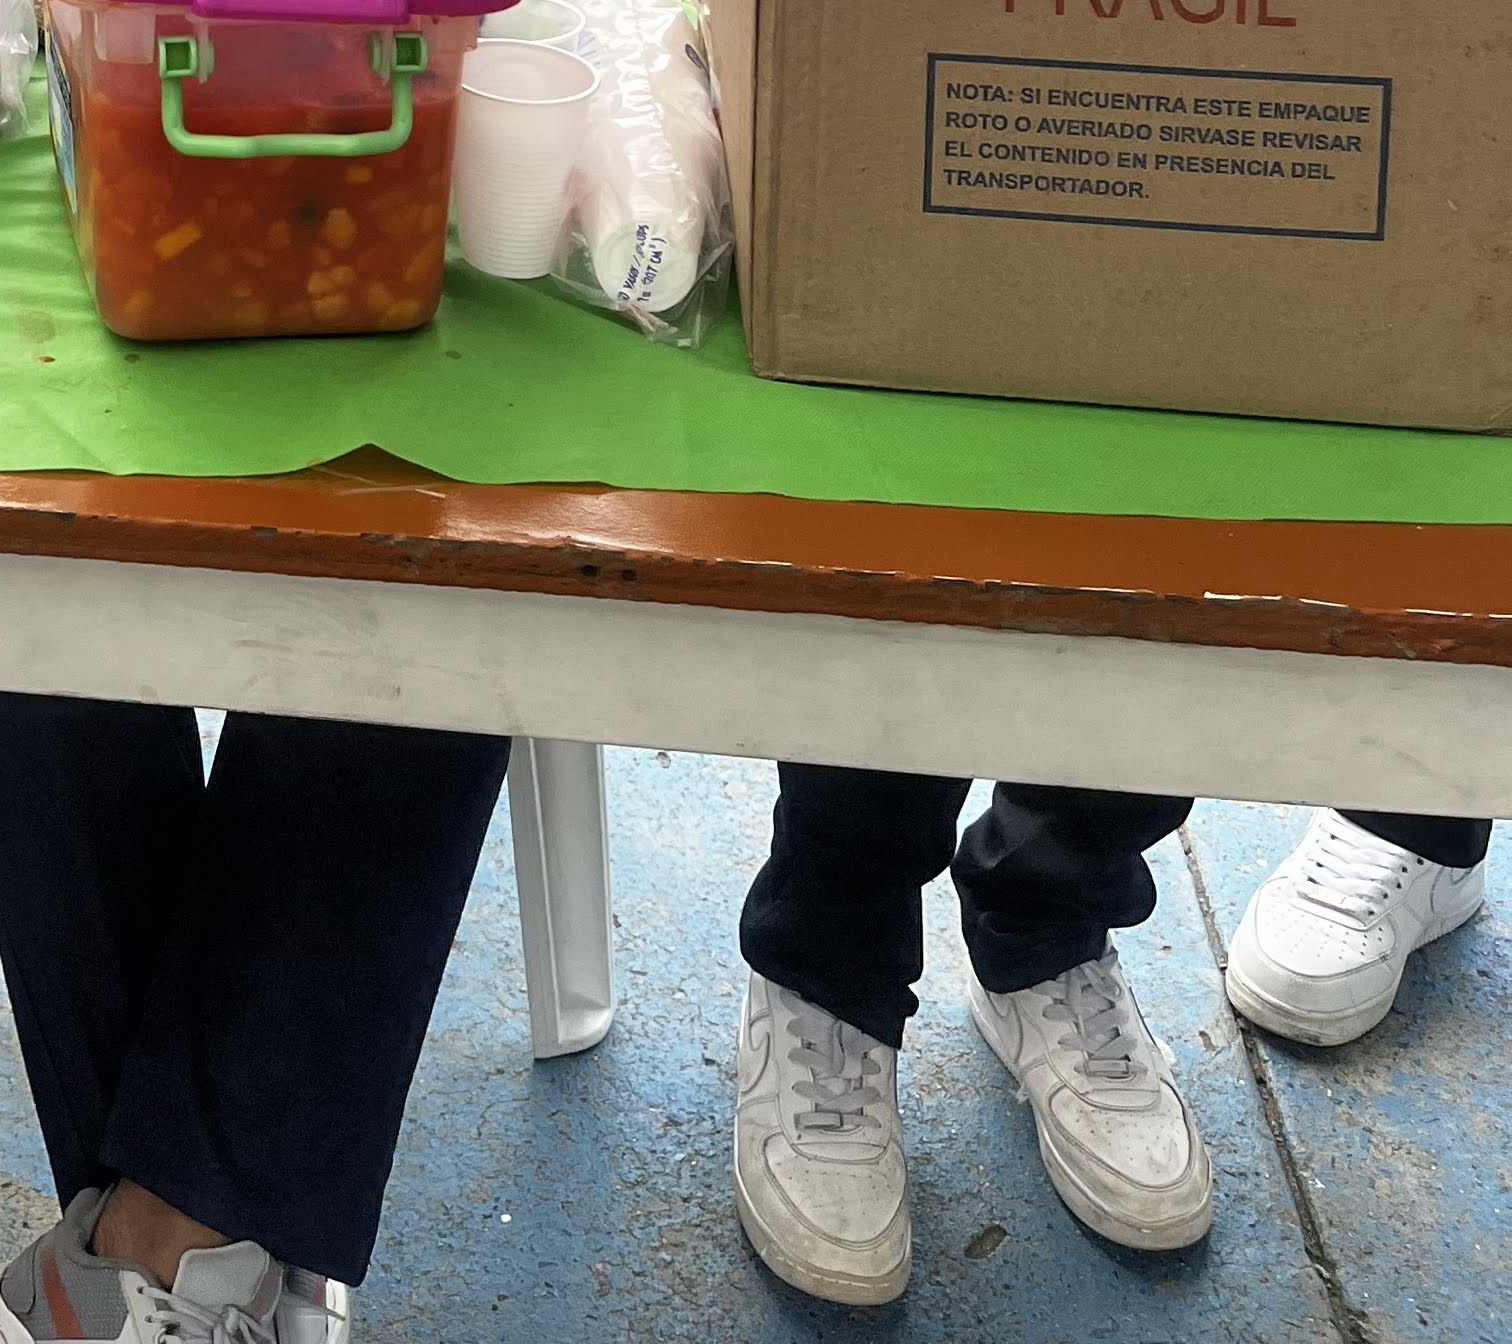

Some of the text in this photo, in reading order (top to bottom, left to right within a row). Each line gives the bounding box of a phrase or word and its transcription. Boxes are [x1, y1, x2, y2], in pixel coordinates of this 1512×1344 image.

[946, 82, 1371, 124] NOTA: SI ENCUENTRA ESTE EMPAQUE
[945, 111, 1362, 153] ROTO O AVERIADO SIRVASE REVISAR
[944, 140, 1335, 181] EL CONTENIDO EN PRESENCIA DEL
[943, 169, 1151, 200] TRANSPORTADOR.
